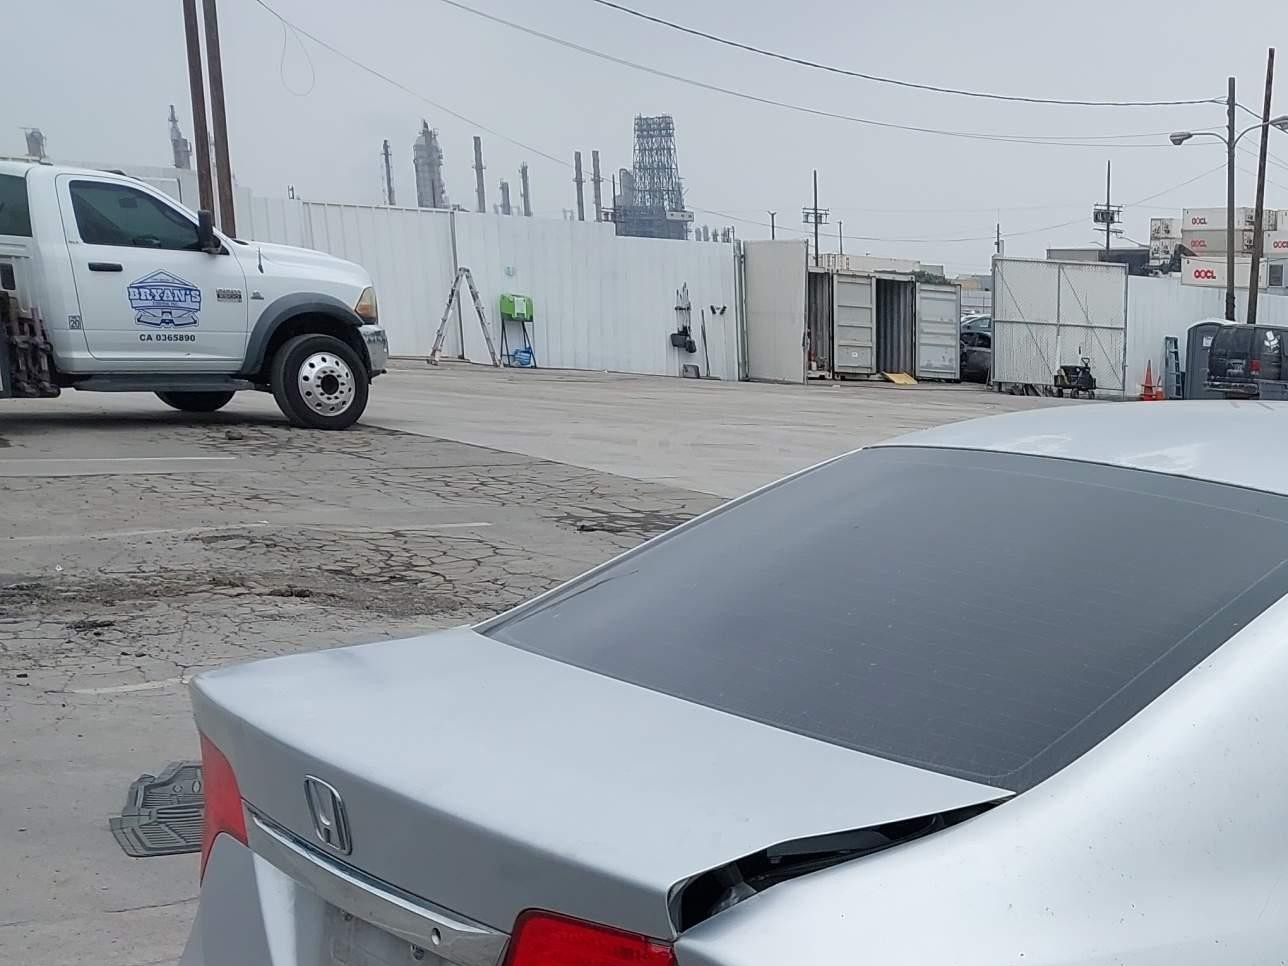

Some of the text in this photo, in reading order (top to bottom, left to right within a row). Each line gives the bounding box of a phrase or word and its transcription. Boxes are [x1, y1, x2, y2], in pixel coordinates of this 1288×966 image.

[1191, 217, 1208, 225] OOCL
[1194, 269, 1217, 279] OOCL
[128, 287, 201, 303] BRYAN'S
[139, 333, 196, 342] CA 0365890
